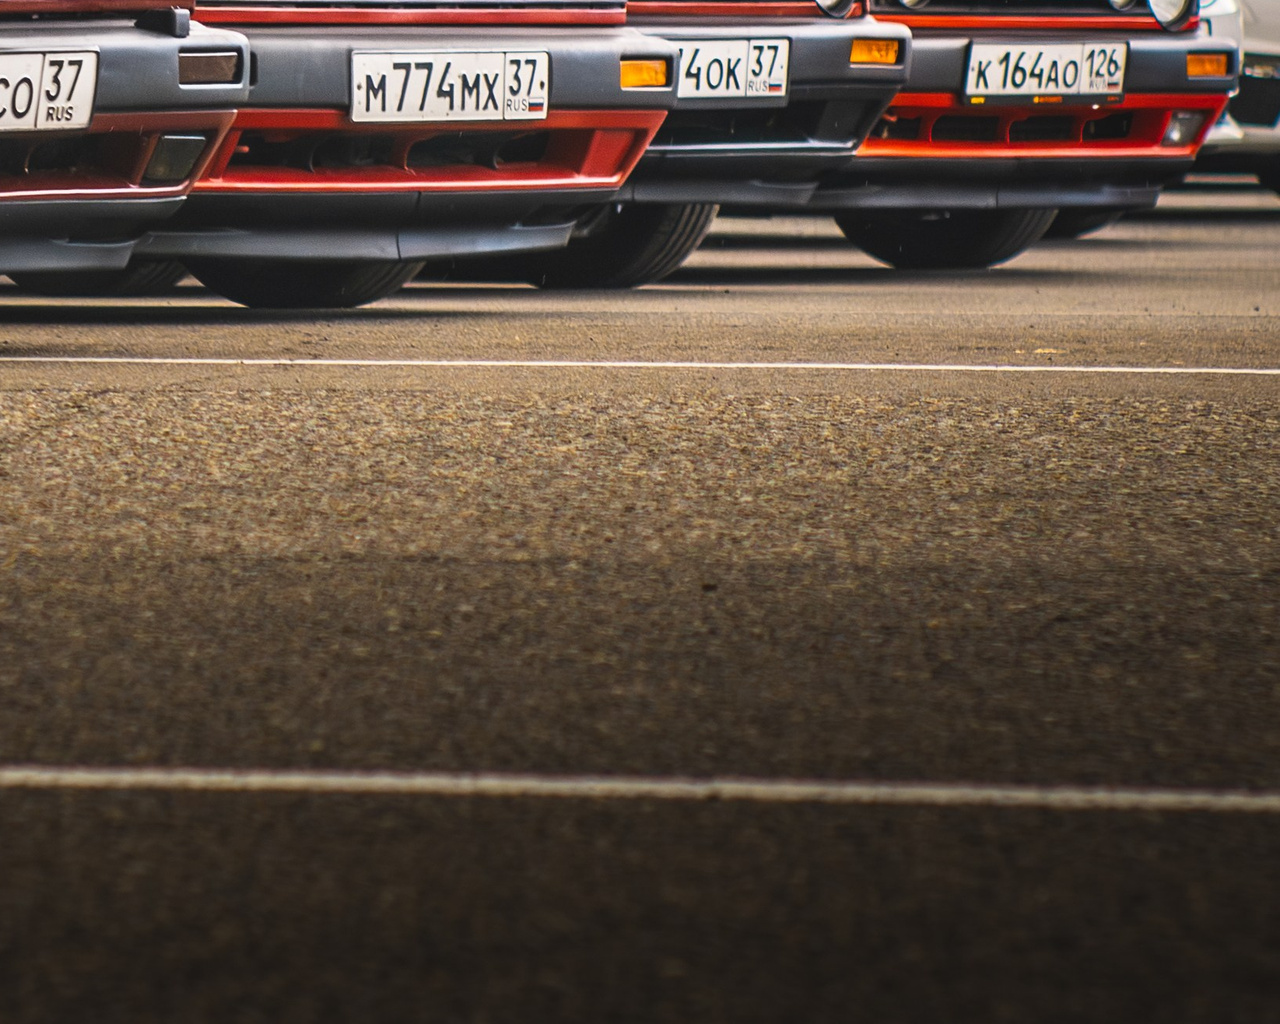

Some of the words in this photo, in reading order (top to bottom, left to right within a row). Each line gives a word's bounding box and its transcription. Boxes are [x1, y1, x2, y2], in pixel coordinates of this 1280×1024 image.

[508, 58, 538, 96] 37
[679, 47, 742, 91] 4OK
[751, 45, 779, 78] 37
[1085, 48, 1120, 77] 126
[45, 59, 84, 102] 37
[748, 80, 768, 92] RUS
[45, 105, 74, 122] RUS
[506, 98, 528, 112] RUS
